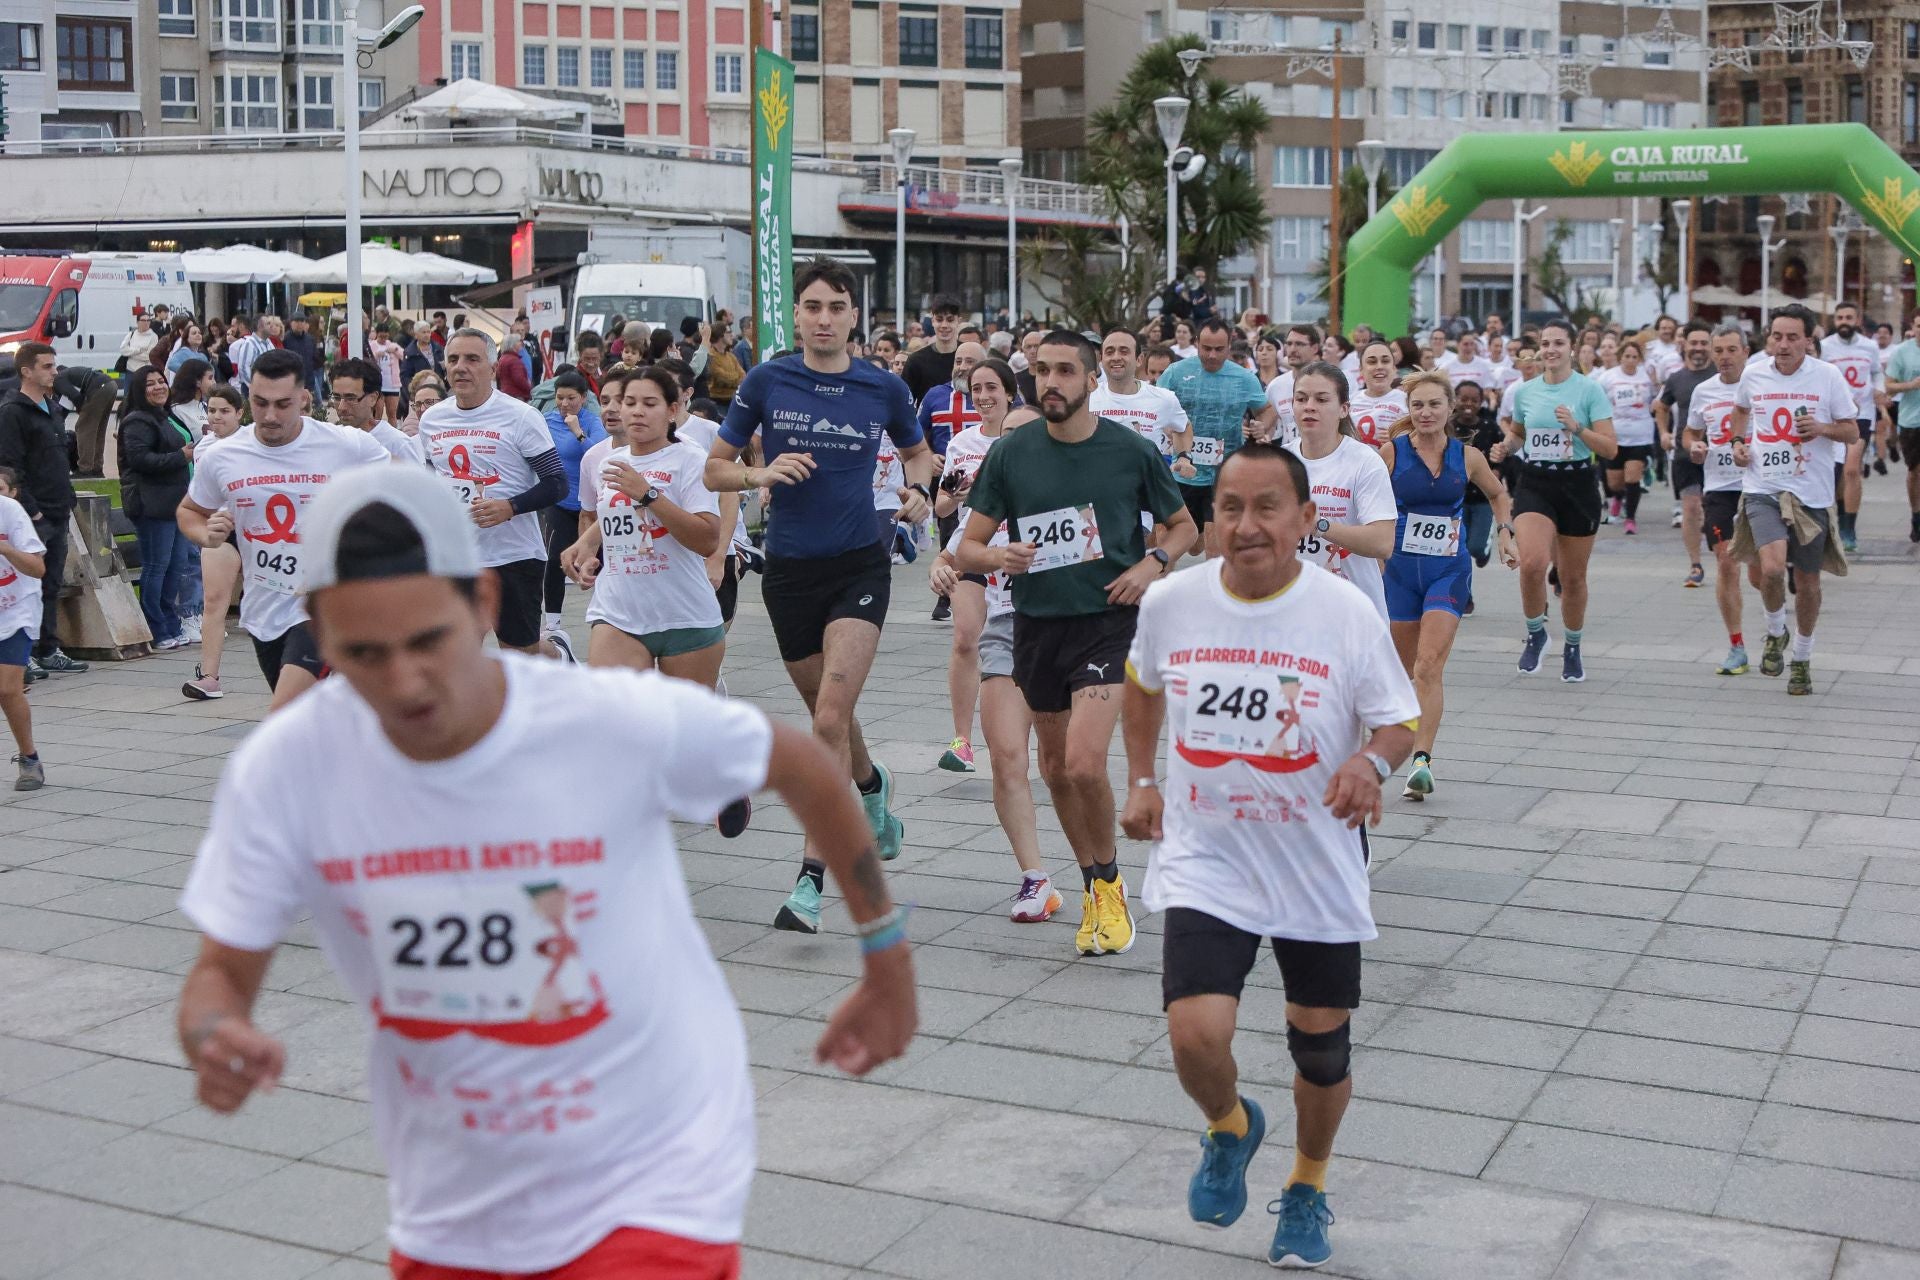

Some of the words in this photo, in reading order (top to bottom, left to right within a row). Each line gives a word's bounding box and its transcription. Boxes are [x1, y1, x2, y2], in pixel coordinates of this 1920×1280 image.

[1610, 146, 1666, 166] CAJA
[1671, 144, 1749, 165] RURAL
[363, 167, 503, 198] NAUTICO
[539, 168, 603, 200] NAUTICO
[1613, 171, 1633, 183] DE
[1637, 170, 1710, 183] ASTURIAS
[760, 163, 773, 327] RURAL
[814, 384, 845, 393] land
[773, 409, 811, 423] KANGAS
[1130, 410, 1157, 420] ANTI-SIDA
[443, 430, 469, 438] CARRERA
[470, 430, 501, 440] ANTI-SIDA
[773, 422, 809, 432] MOUNTAIN
[870, 421, 881, 440] HALF
[800, 439, 847, 450] MAYADOR
[1532, 434, 1560, 447] 064
[1763, 451, 1790, 466] 268
[227, 479, 244, 492] XXIV
[246, 474, 286, 487] CARRERA
[1312, 485, 1351, 499] ANTI-SIDA
[603, 515, 634, 536] 025
[1028, 519, 1075, 548] 246
[1412, 522, 1446, 540] 188
[257, 549, 297, 575] 043
[1169, 650, 1191, 666] XXIV
[1195, 648, 1256, 664] CARRERA
[1260, 651, 1329, 680] ANTI-SIDA
[1197, 683, 1269, 721] 248
[481, 838, 603, 869] ANTI-SIDA
[391, 913, 513, 966] 228
